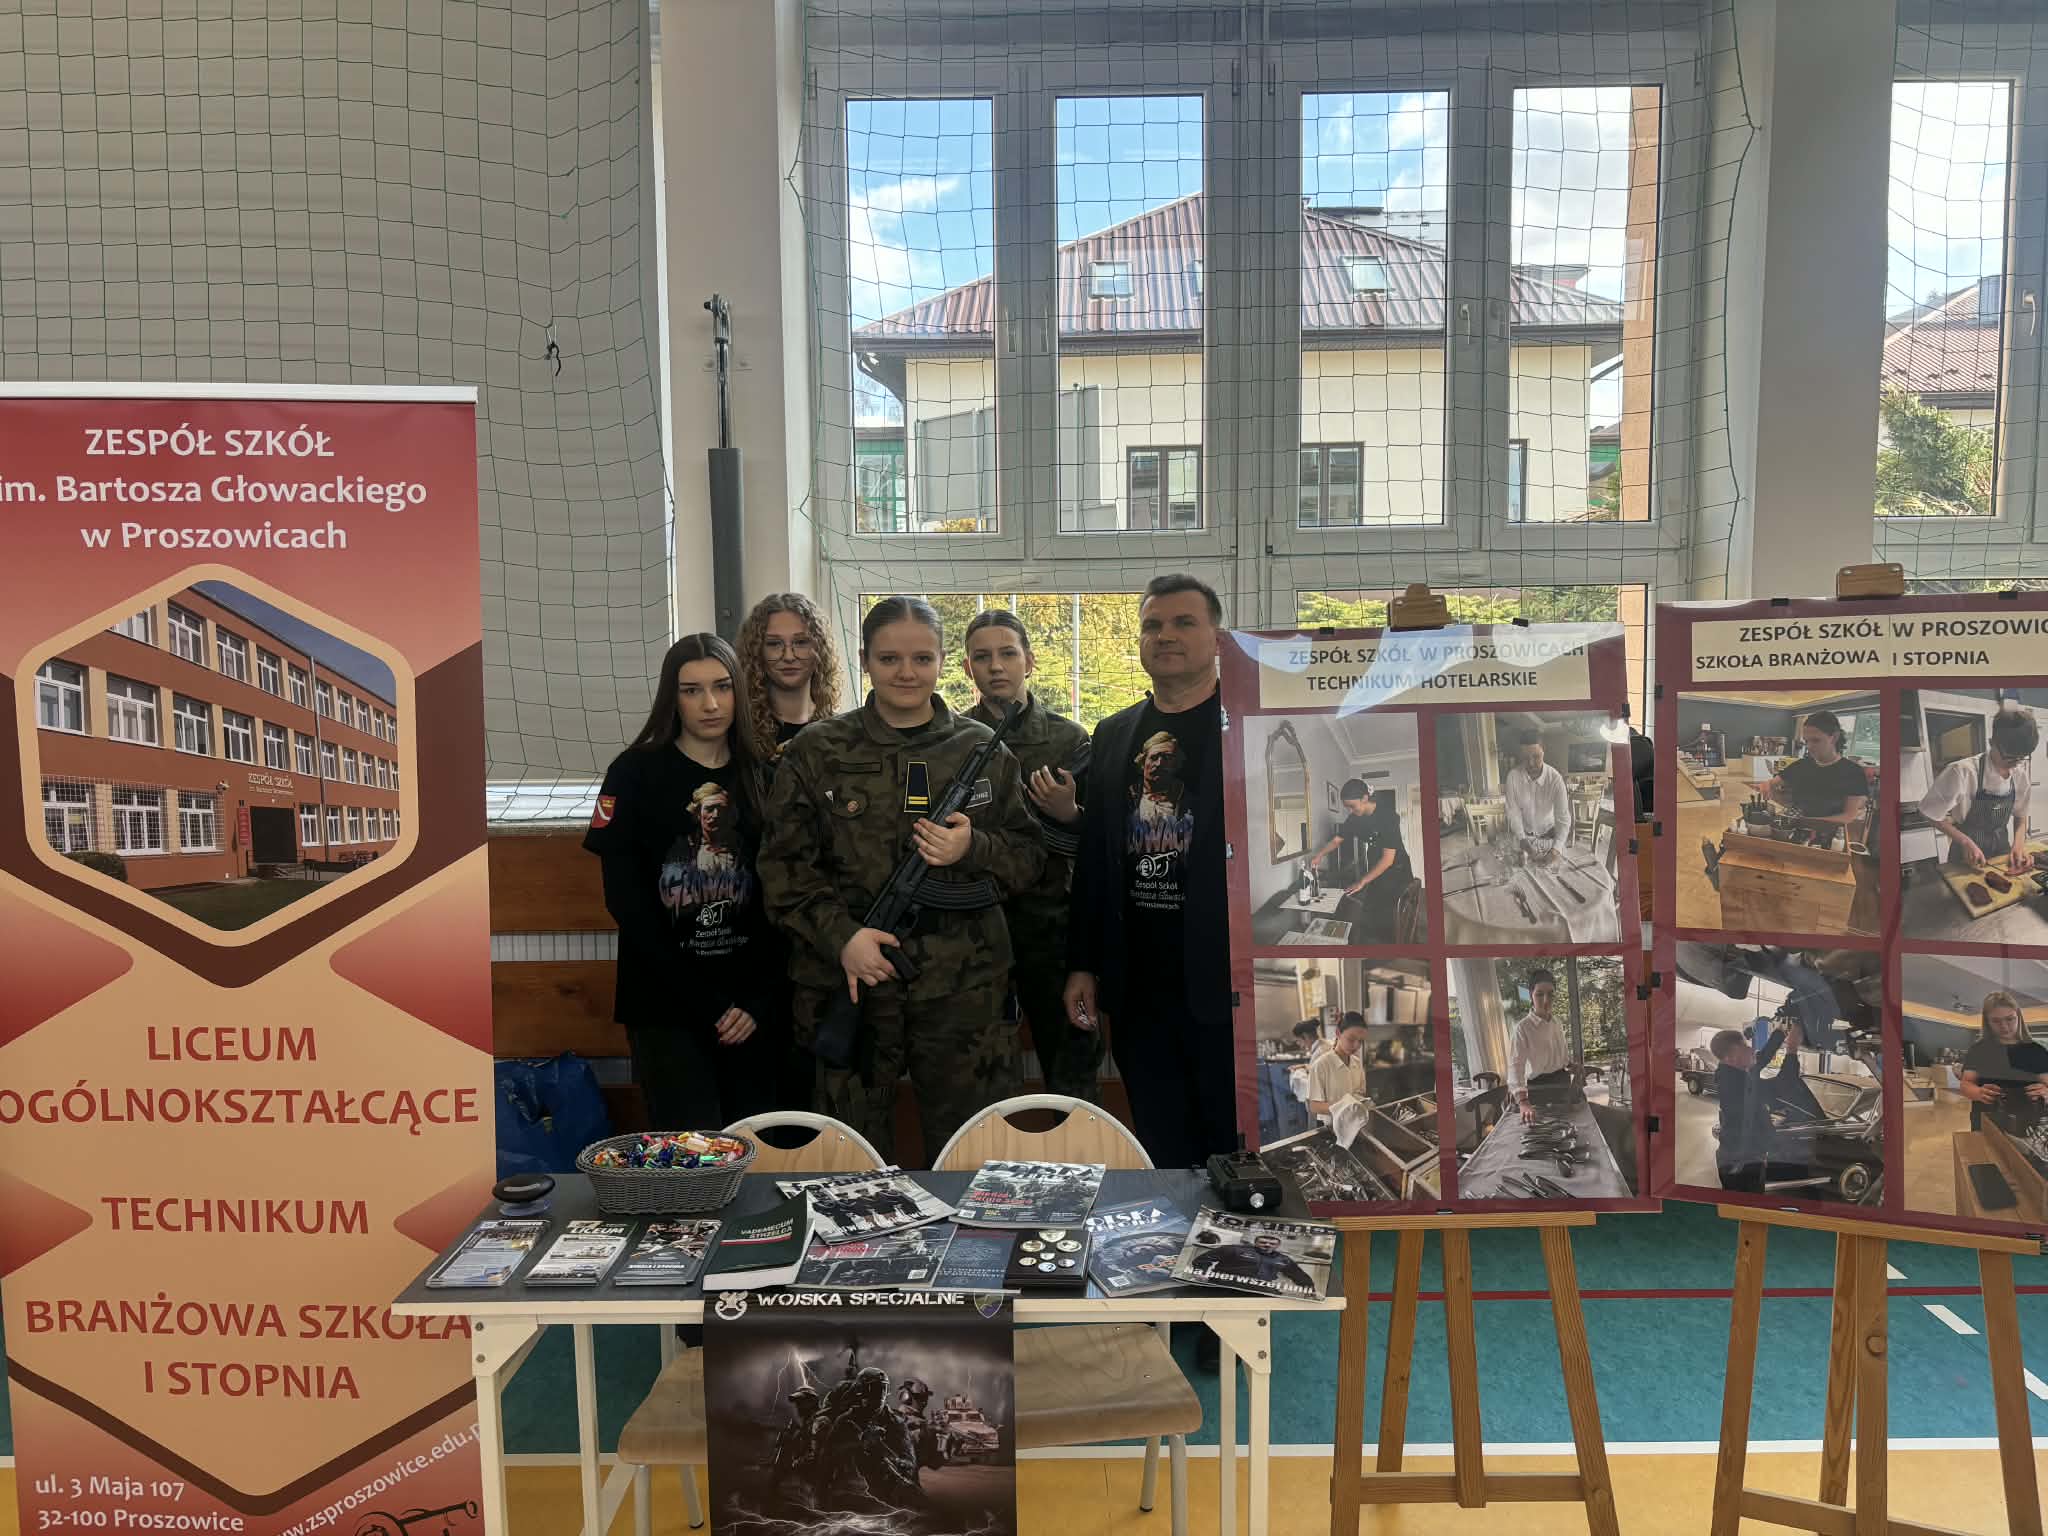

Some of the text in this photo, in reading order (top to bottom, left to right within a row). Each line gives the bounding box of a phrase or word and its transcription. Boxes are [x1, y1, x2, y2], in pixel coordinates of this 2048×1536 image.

[85, 422, 335, 457] ZESPÓŁ SZKÓŁ
[56, 475, 202, 502] Bartosza
[211, 474, 427, 512] Głowackiego
[80, 520, 347, 549] w Proszowicach
[1739, 621, 1813, 642] ZESPÓŁ
[1818, 619, 1884, 640] SZKÓŁ
[1893, 622, 1915, 638] W
[1289, 640, 1584, 665] ZESPÓŁ SZKÓŁ W PROSZOWICACH
[1696, 649, 1990, 670] SZKOŁA BRANŻOWA I STOPNIA
[1307, 671, 1538, 692] TECHNIKUM HOTELARSKIE
[147, 1026, 317, 1061] LICEUM
[0, 1079, 479, 1136] OGÓLNOKSZTAŁCĄCE
[101, 1197, 369, 1235] TECHNIKUM
[741, 1218, 794, 1234] VADEMECUM
[757, 1292, 965, 1306] WOJSKA SPECJALNE
[26, 1291, 473, 1340] BRANŻOWA SZKOŁA
[144, 1361, 360, 1399] I STOPNIA
[35, 1472, 185, 1501] ul. 3 Maja 107
[277, 1423, 481, 1536] w.zsproszowice.edu.p
[38, 1508, 244, 1531] 32-100 Proszowice
